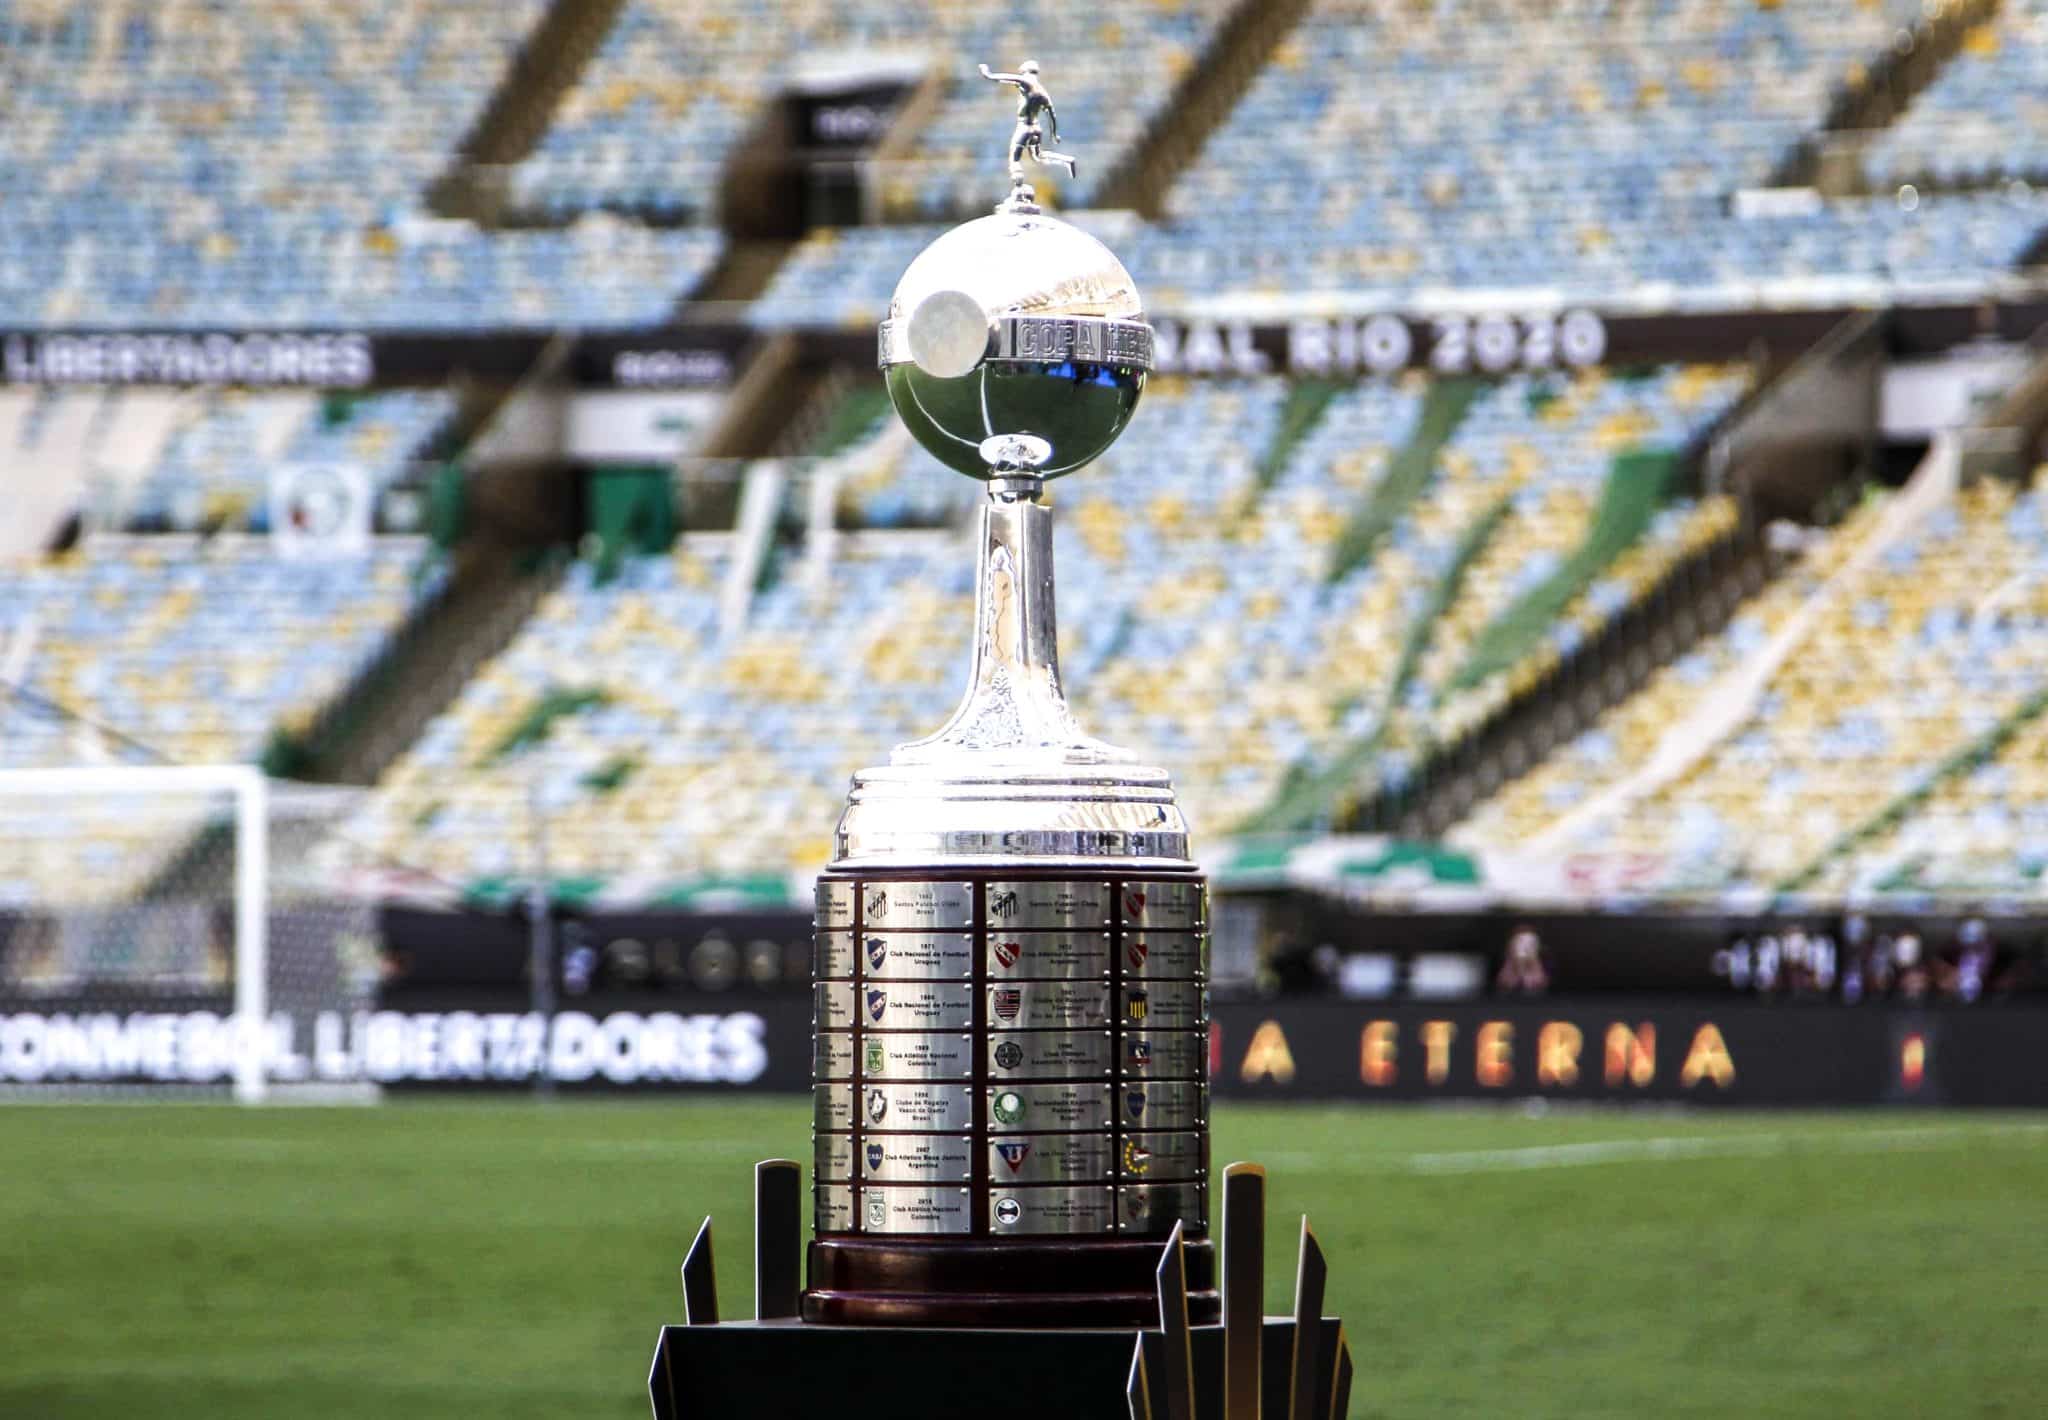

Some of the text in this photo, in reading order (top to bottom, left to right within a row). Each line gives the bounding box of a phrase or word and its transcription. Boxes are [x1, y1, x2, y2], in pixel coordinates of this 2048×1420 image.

[3, 332, 373, 386] LIBERTADORES
[1018, 322, 1097, 356] COPA
[1288, 314, 1411, 374] RIO
[1429, 307, 1607, 374] 2020
[1359, 1019, 1736, 1088] ETERNA
